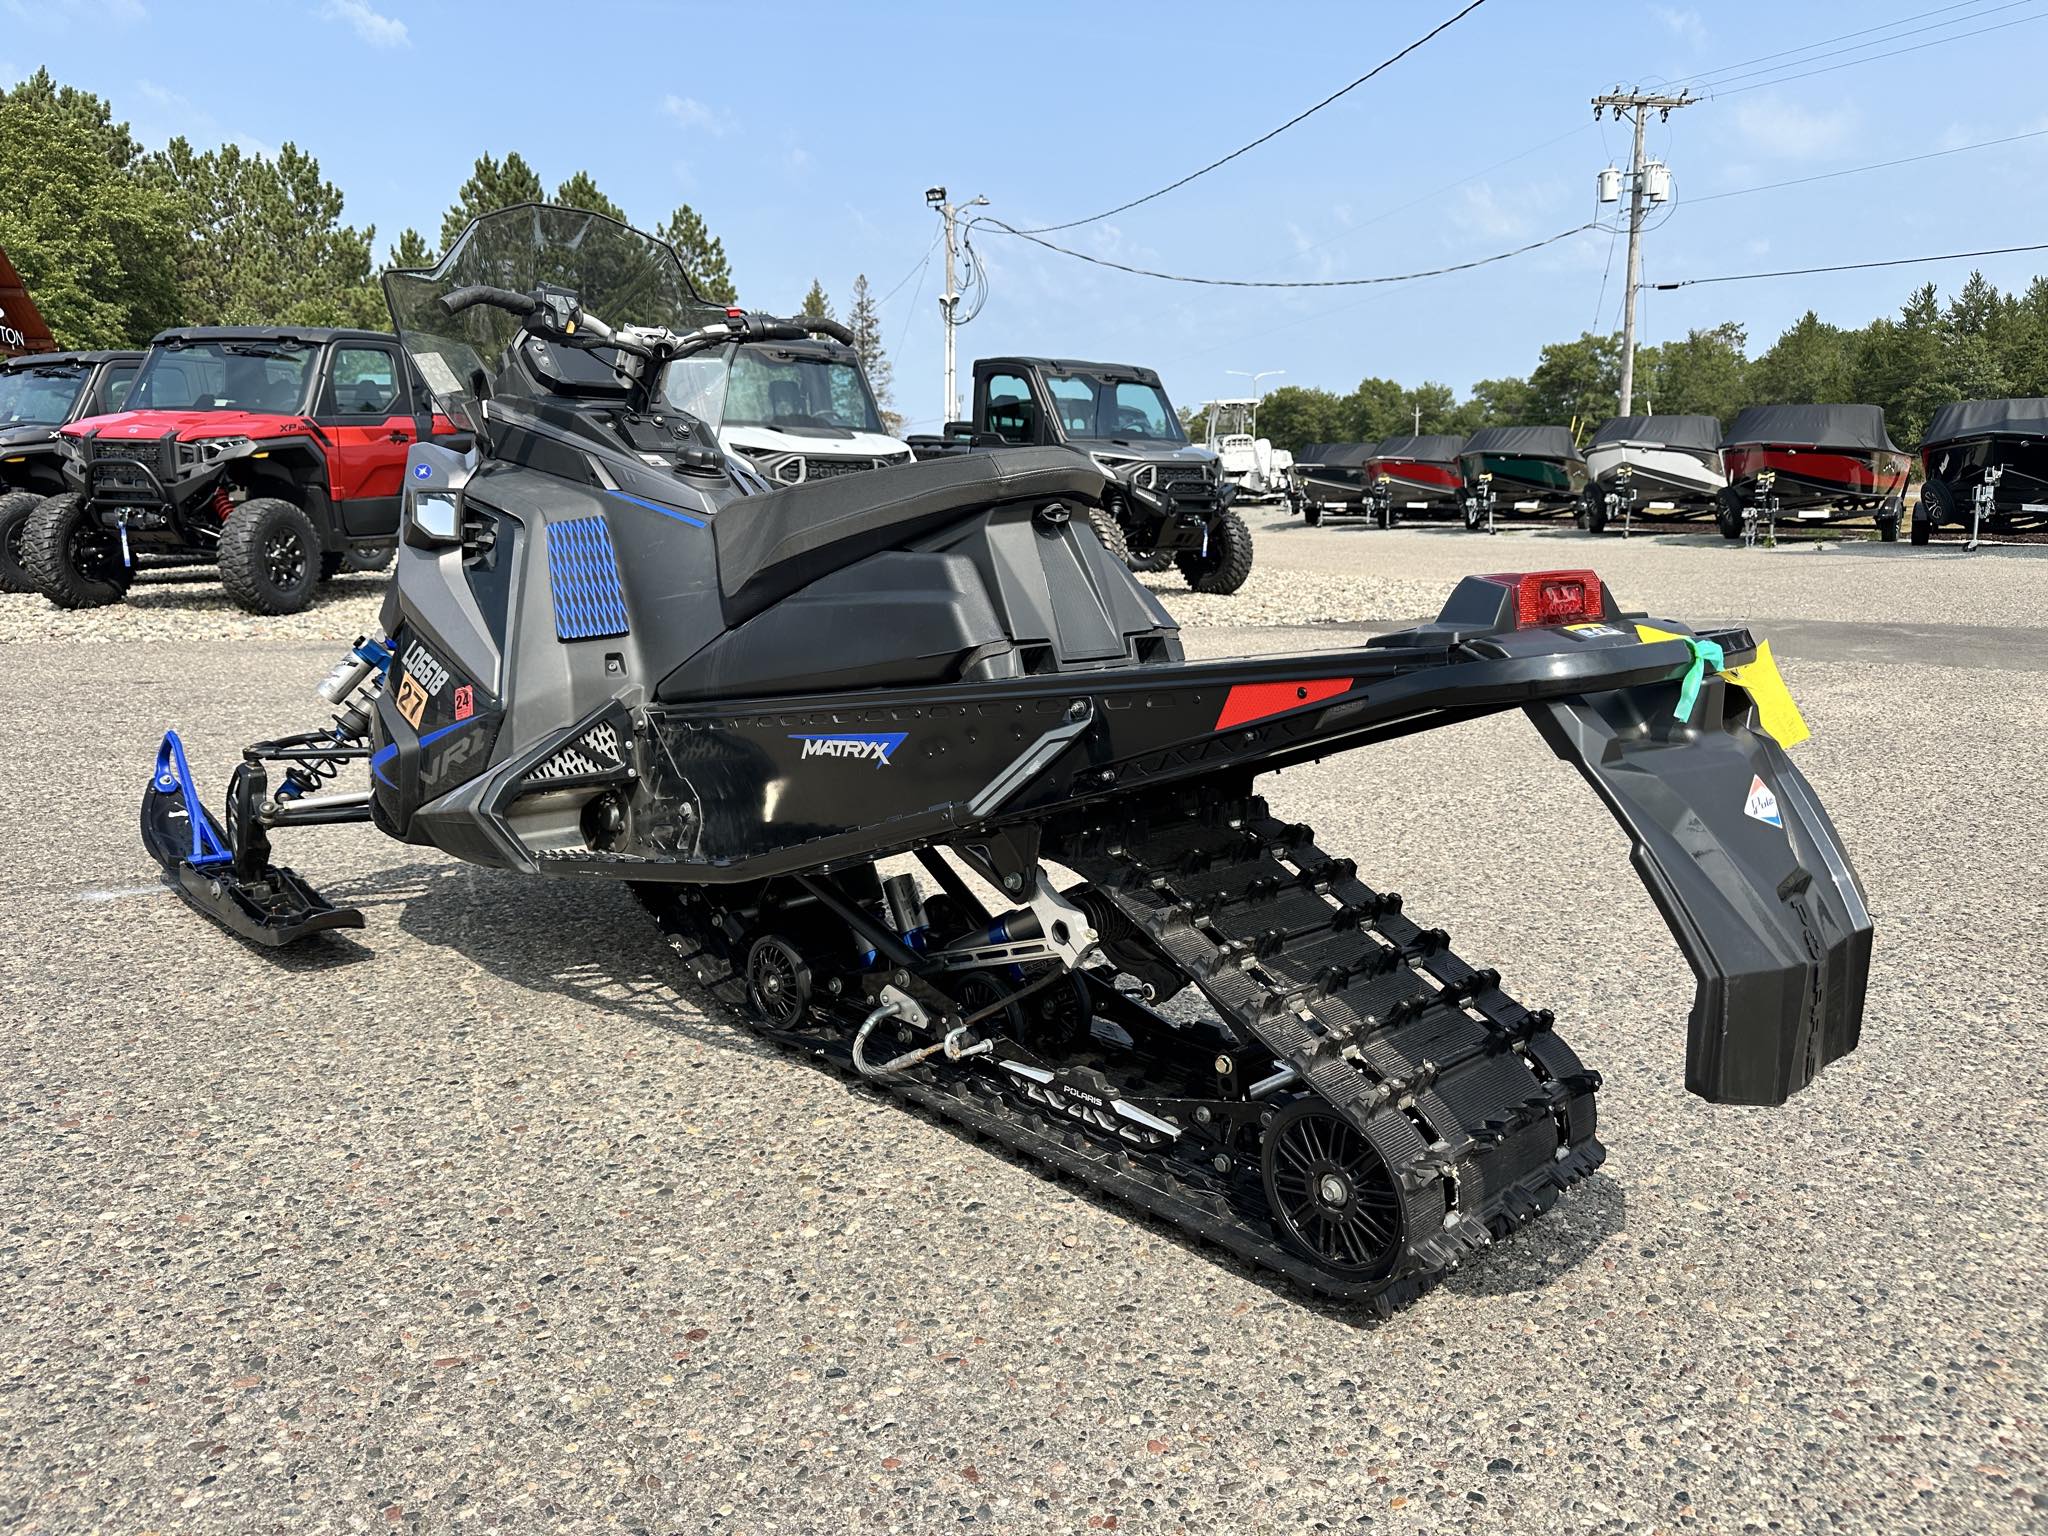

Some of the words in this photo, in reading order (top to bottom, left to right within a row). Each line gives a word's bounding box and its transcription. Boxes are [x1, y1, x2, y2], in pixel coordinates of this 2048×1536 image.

[48, 431, 61, 439] X
[280, 424, 297, 432] XP
[398, 681, 423, 720] 27
[456, 692, 469, 710] 24
[801, 738, 891, 765] MATRYX
[1063, 1085, 1103, 1107] POLARIS
